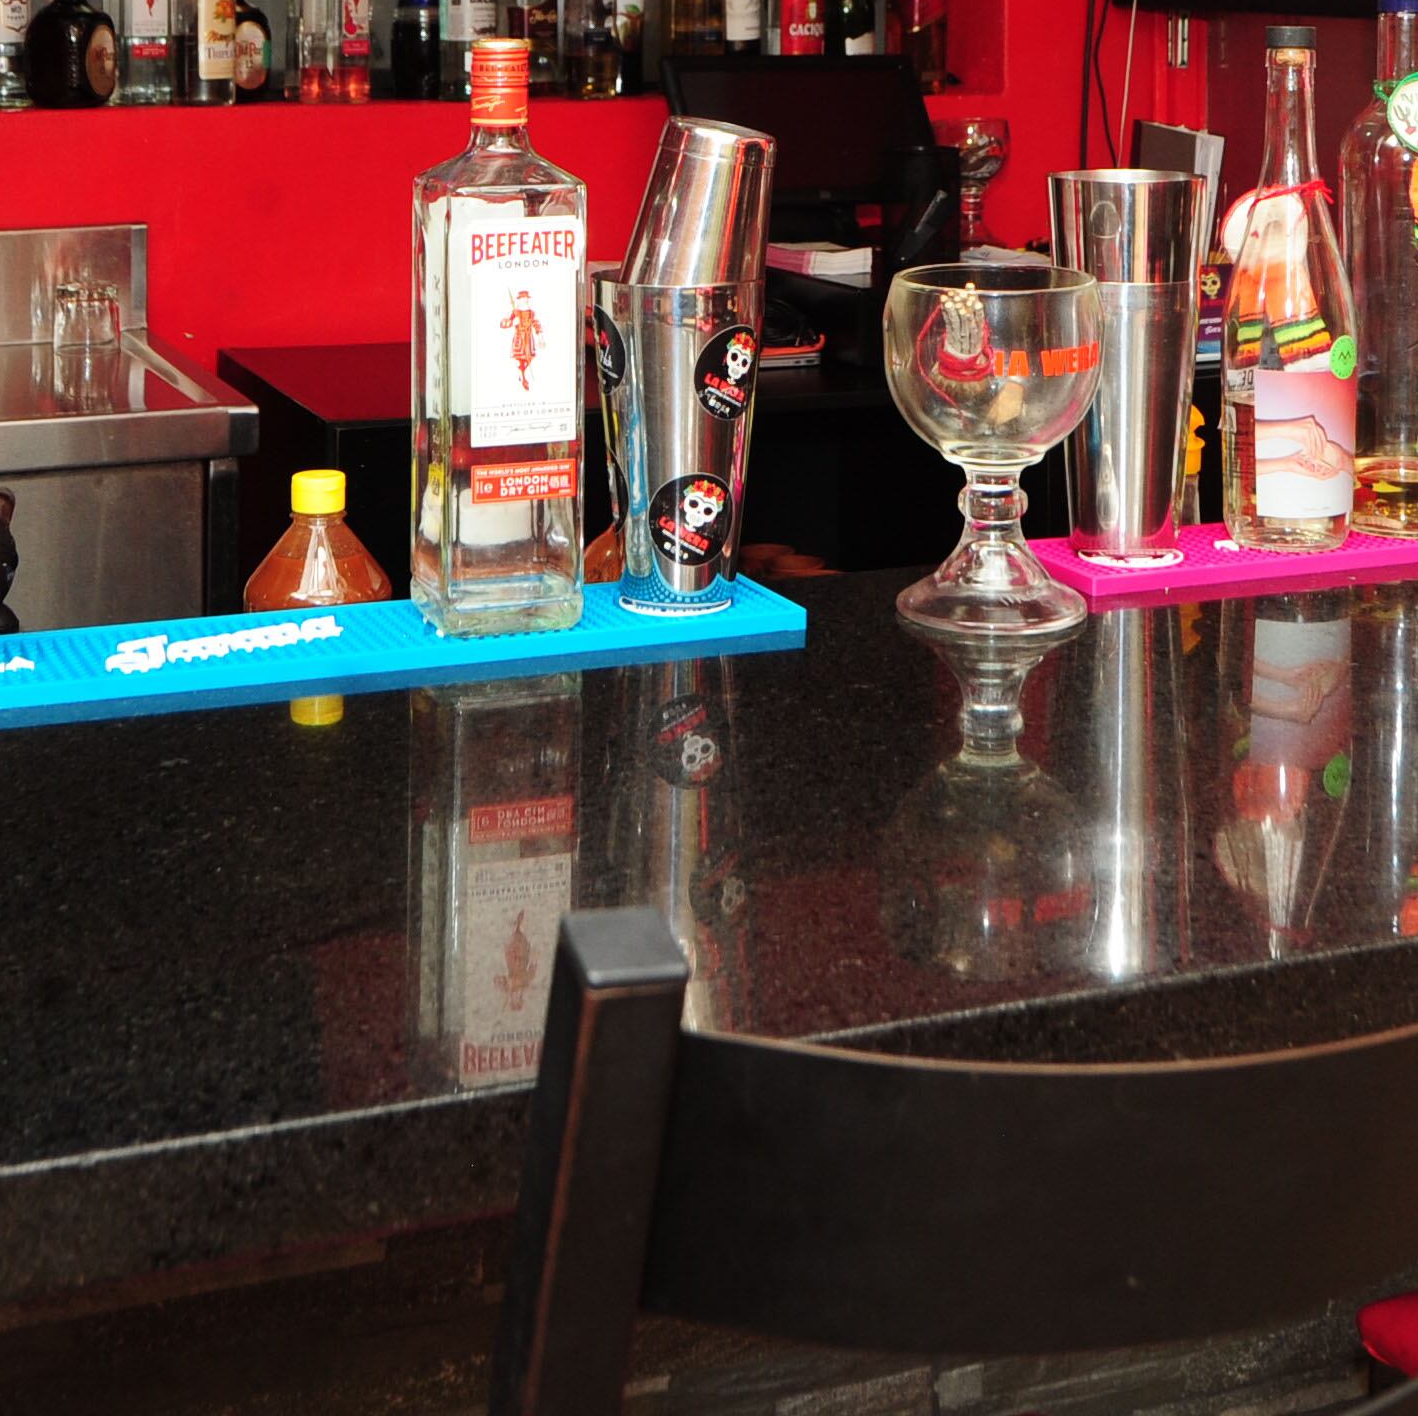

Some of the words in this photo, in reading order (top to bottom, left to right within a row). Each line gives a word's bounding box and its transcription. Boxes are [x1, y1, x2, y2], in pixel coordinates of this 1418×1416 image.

[472, 230, 575, 266] BEEFEATER
[498, 259, 549, 270] LONDON
[1040, 341, 1100, 377] WERA
[500, 474, 549, 487] LONDON
[500, 486, 523, 497] DRY
[527, 484, 549, 495] GIN
